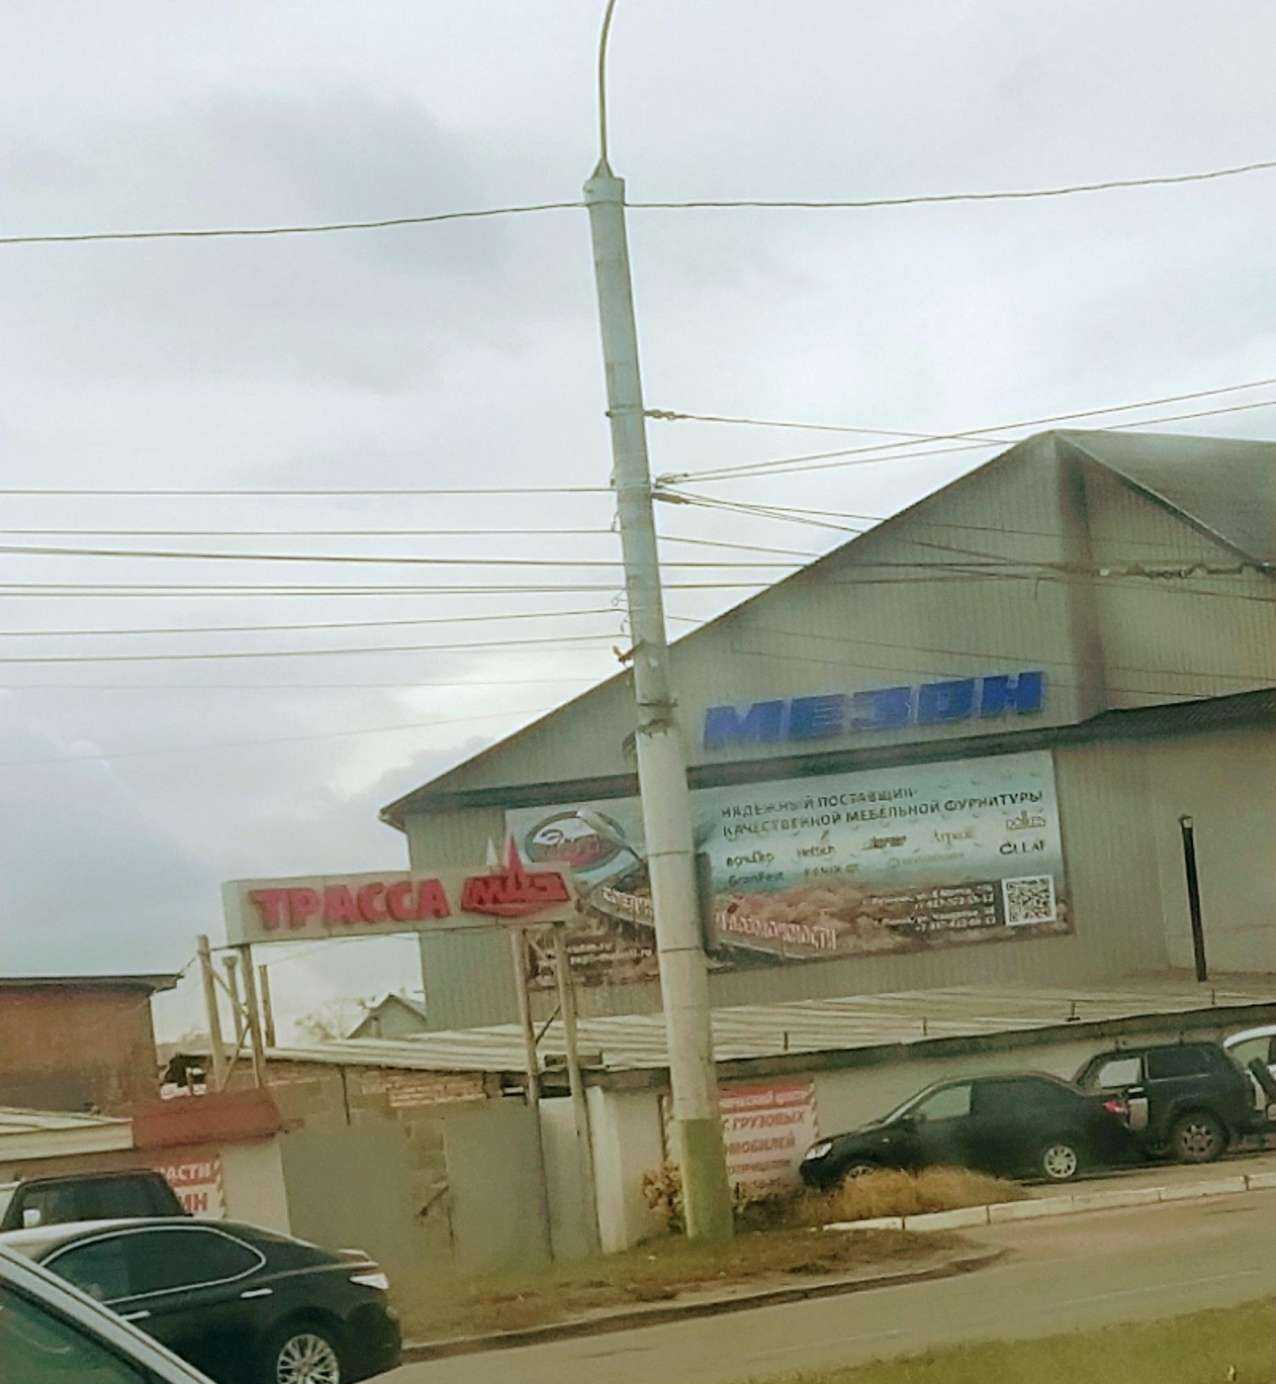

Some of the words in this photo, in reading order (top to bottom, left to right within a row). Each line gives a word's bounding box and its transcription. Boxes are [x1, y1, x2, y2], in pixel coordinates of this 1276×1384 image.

[703, 671, 1046, 751] МЕЗОН
[722, 813, 842, 837] КАЧЕСТВЕННОЙ
[845, 802, 940, 822] МЕБЕЛЬНОЙ
[943, 790, 1043, 812] ФУРНИТУРЫ
[248, 878, 452, 931] ТРАССА
[727, 1130, 796, 1155] МОБИЛЕЙ
